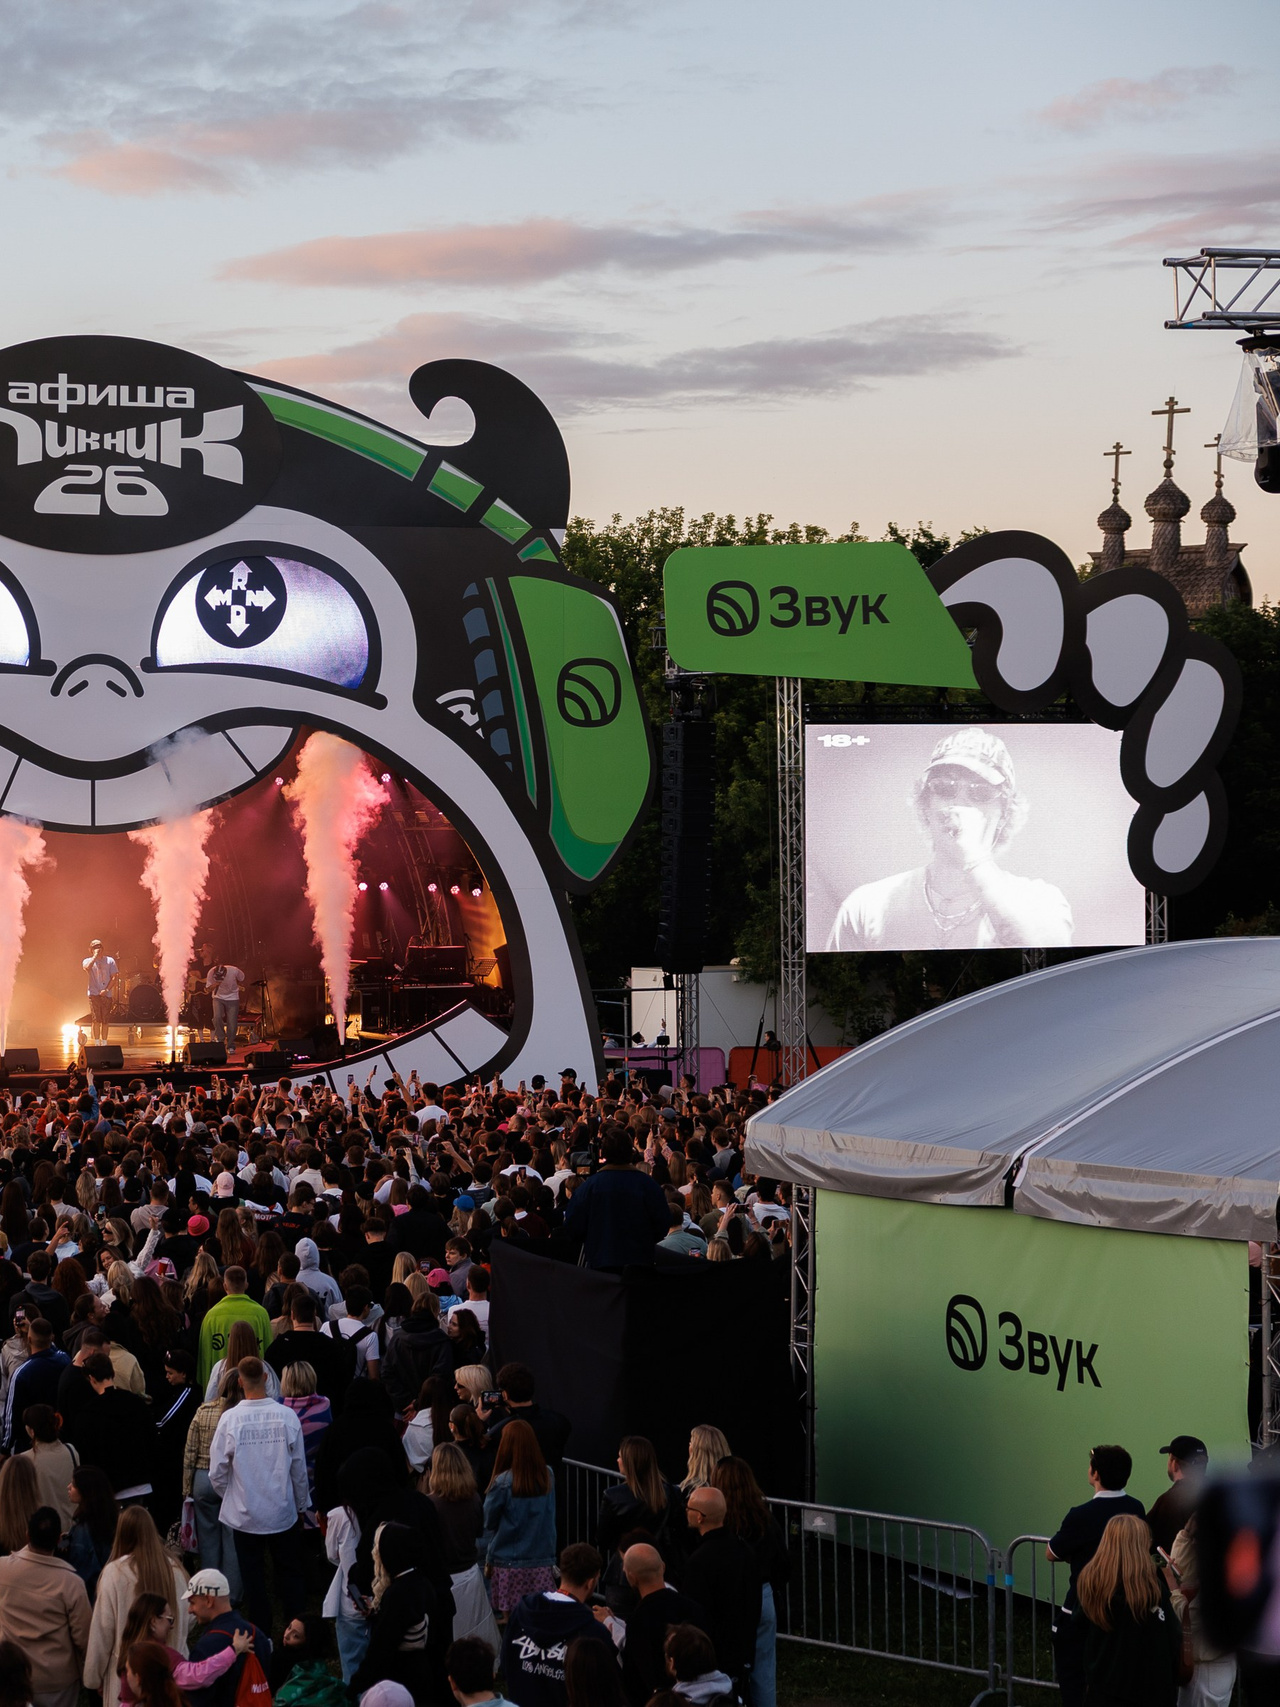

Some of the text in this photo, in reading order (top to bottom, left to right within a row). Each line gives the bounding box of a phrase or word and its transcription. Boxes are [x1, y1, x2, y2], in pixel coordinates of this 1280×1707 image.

[7, 372, 195, 414] афиша
[33, 464, 169, 517] 26
[769, 584, 890, 635] Звук
[817, 733, 871, 748] 18+
[998, 1310, 1103, 1392] Звук
